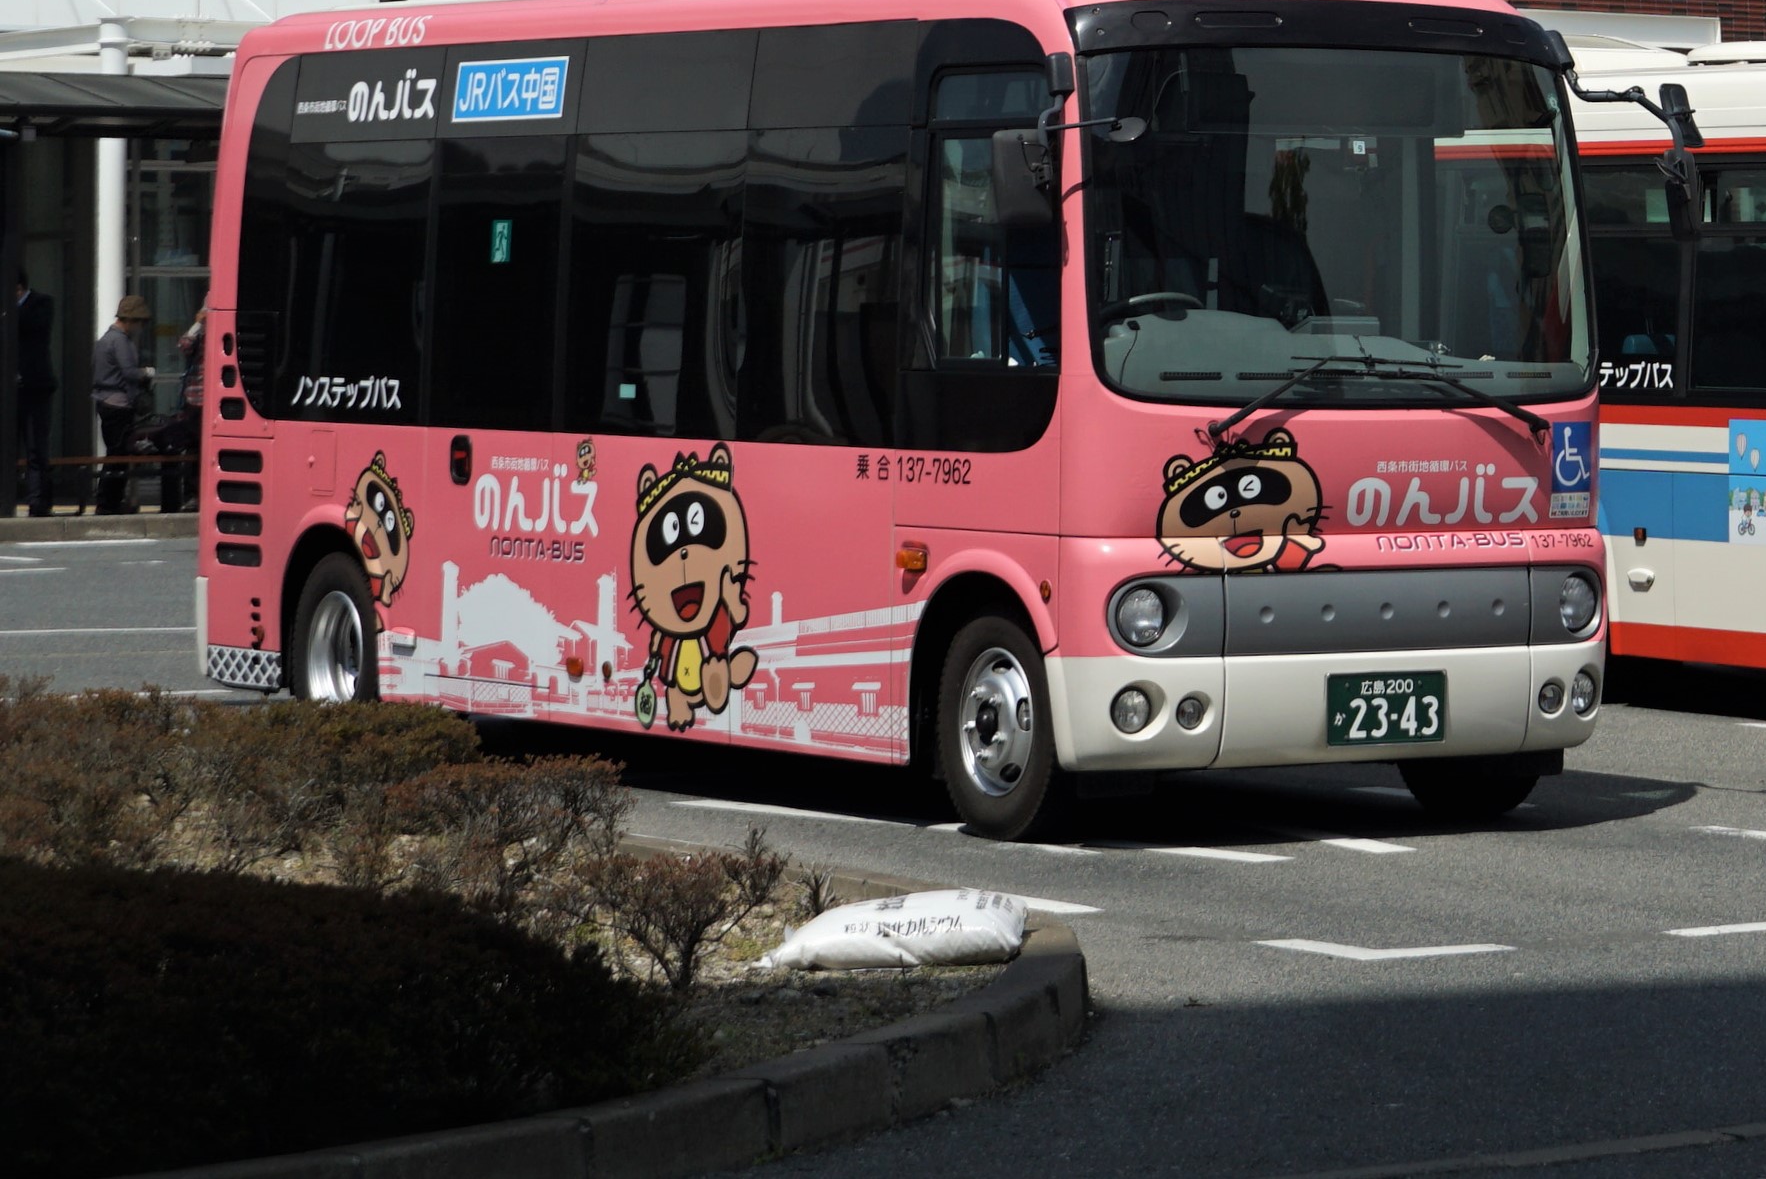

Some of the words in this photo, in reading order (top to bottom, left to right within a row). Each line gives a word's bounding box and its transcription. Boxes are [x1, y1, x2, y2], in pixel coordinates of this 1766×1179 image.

[324, 18, 388, 50] LOOP
[384, 14, 433, 46] BUS
[348, 68, 437, 122] のんバス
[459, 67, 560, 113] JRバス中国
[291, 375, 401, 409] ノンステップバス
[1599, 361, 1674, 389] テップバス
[897, 455, 972, 485] 137-7962
[1376, 461, 1468, 473] 西条市街地循環バス
[474, 463, 599, 538] のんバス
[1346, 463, 1539, 527] のんバス
[1530, 533, 1595, 549] 137-7962
[1349, 695, 1439, 739] 23-43
